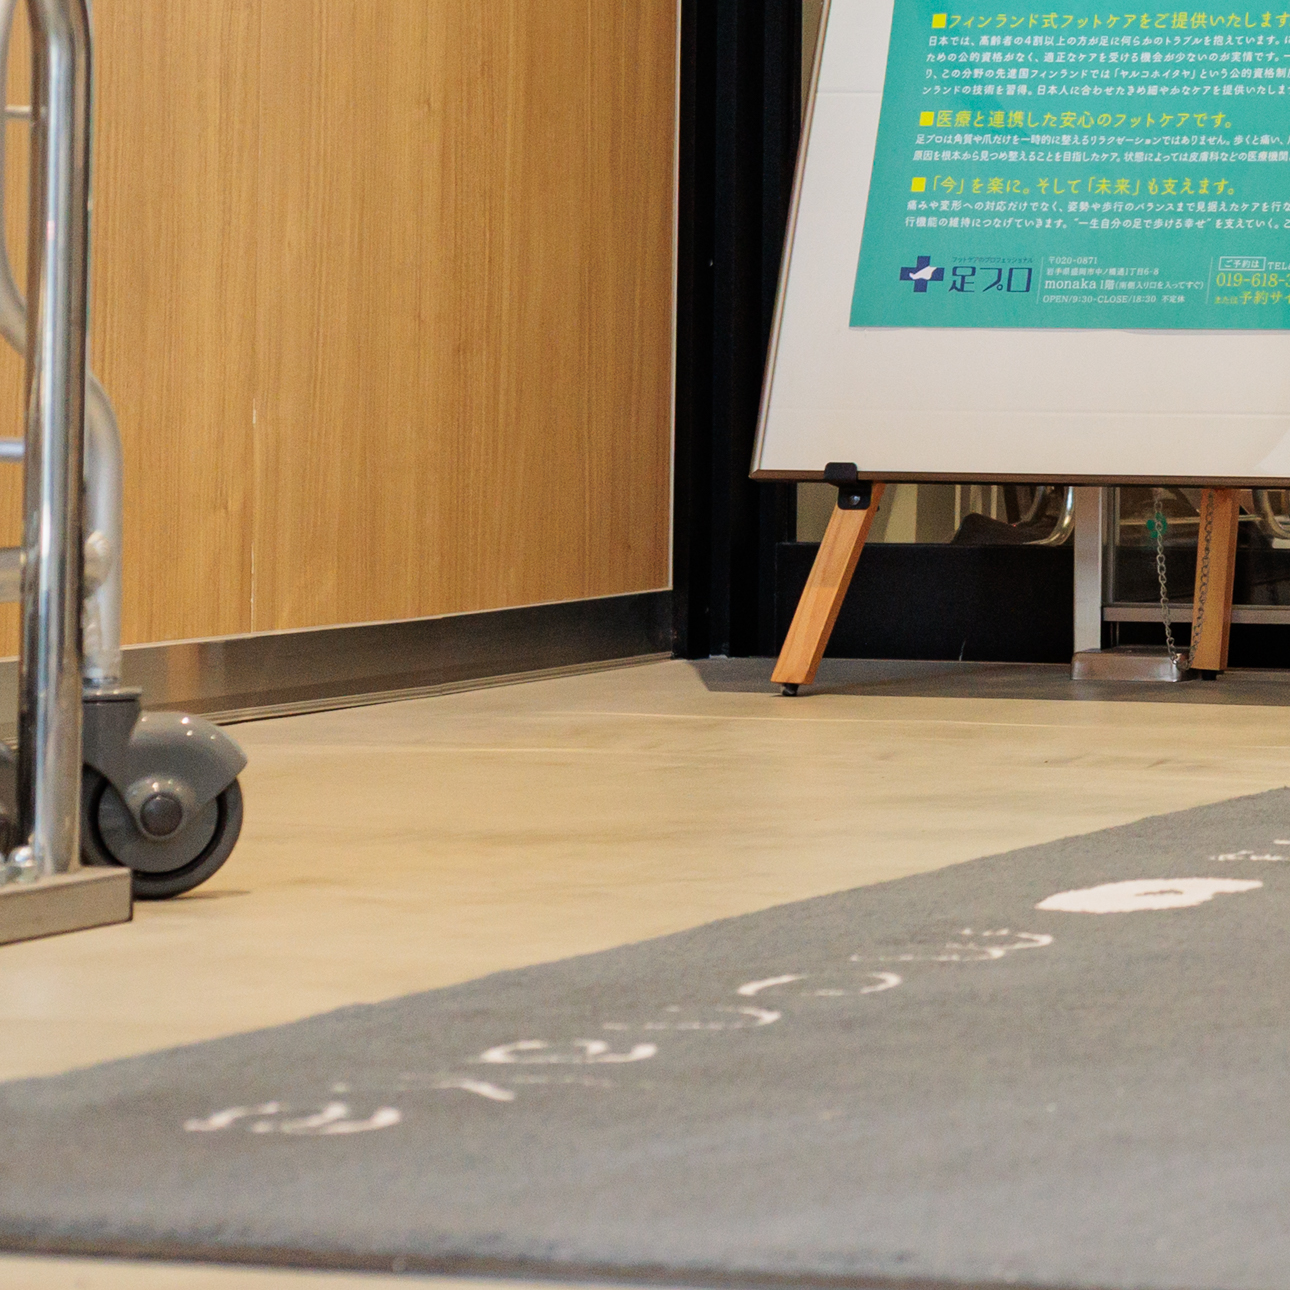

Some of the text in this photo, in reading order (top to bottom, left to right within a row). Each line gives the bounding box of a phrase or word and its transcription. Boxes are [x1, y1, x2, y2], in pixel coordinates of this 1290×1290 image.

[937, 110, 1232, 128] 医療と連携した安心のフットケアです。
[933, 175, 1235, 196] 「今」を楽に。そして「未来」も支えます。
[1223, 259, 1261, 269] ご予約は
[949, 266, 1033, 293] 足プロ
[1044, 277, 1096, 290] monaka
[1161, 294, 1186, 303] 不定休
